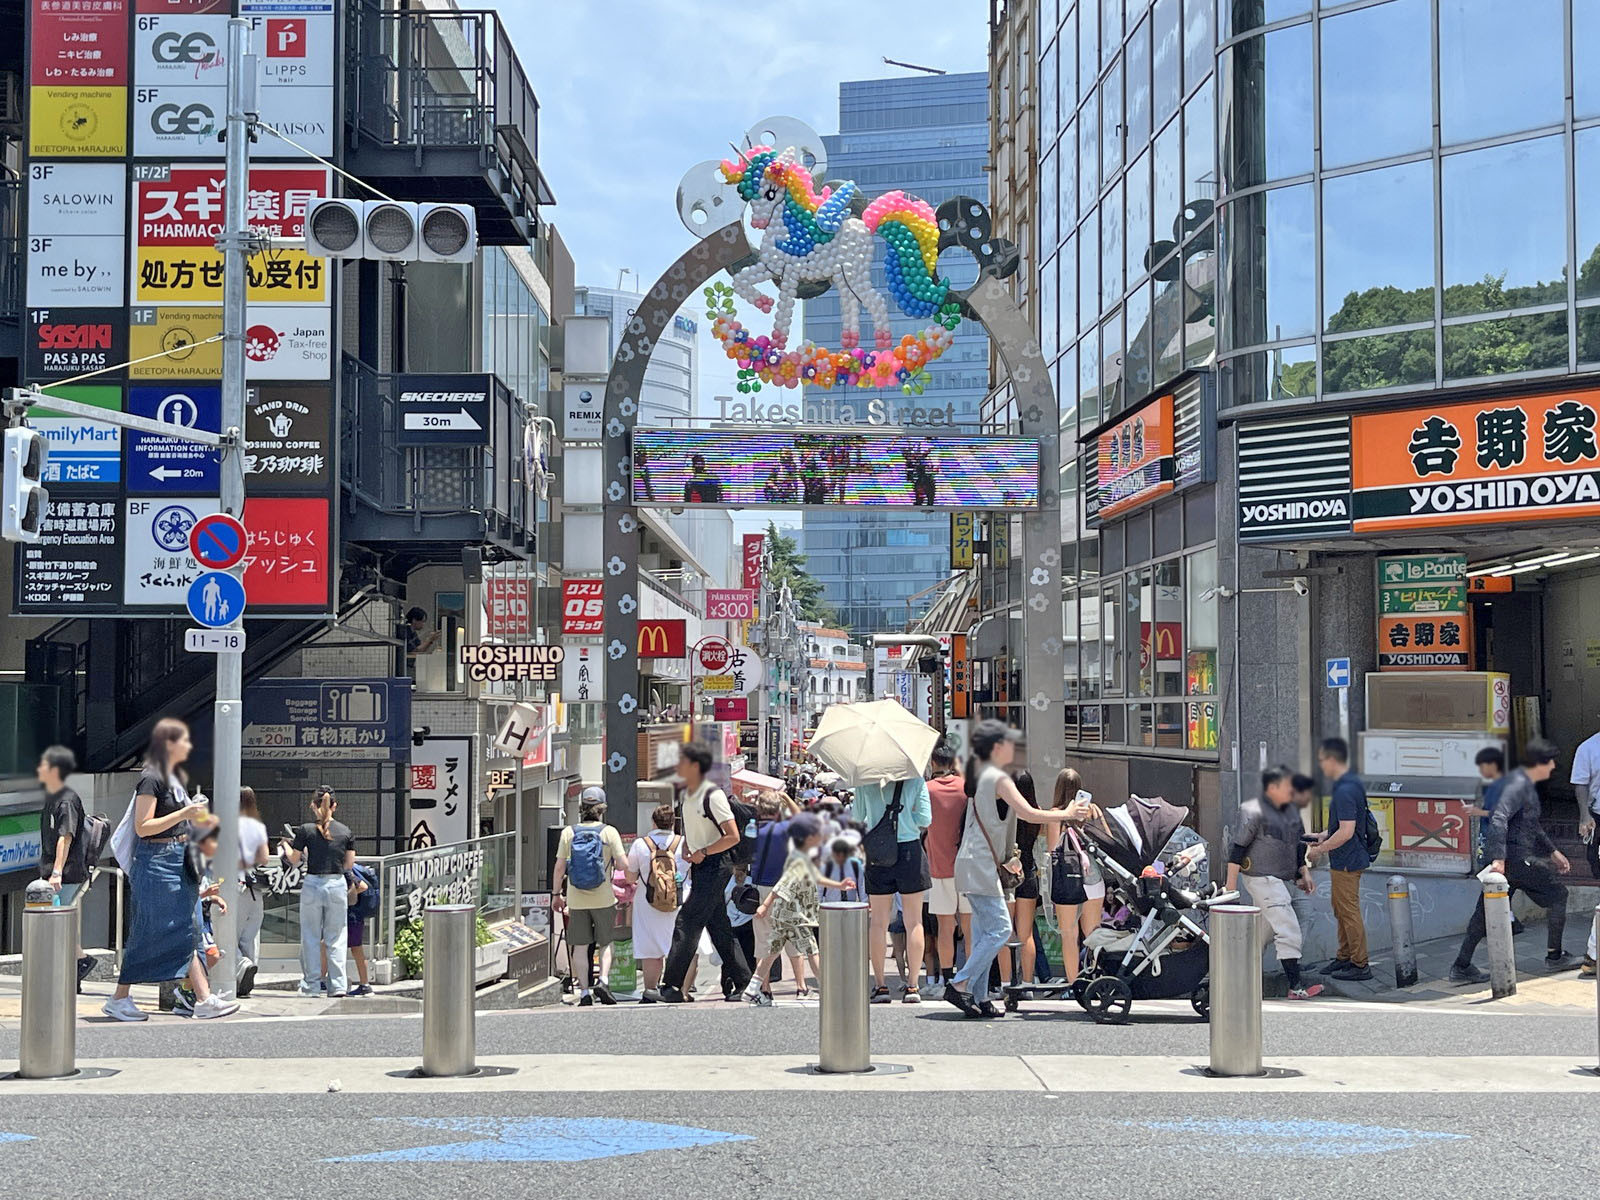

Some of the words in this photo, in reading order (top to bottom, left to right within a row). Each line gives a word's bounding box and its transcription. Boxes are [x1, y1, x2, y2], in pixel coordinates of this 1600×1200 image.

[138, 17, 160, 31] 6F
[63, 32, 98, 42] しみ治療
[57, 50, 102, 60] ニキビ治療
[45, 67, 115, 77] しわ・たるみ治療
[265, 65, 307, 76] LIPPS
[47, 91, 78, 99] Vending
[137, 89, 159, 103] 5F
[34, 145, 76, 153] BEETOPIA
[78, 145, 123, 153] HARAJUKU
[32, 166, 54, 180] 3F
[134, 166, 169, 179] 1F/2F
[43, 193, 113, 206] SALOWIN
[31, 238, 53, 253] 3F
[41, 264, 68, 277] me
[31, 310, 49, 324] 1F
[134, 310, 153, 323] 1F
[160, 312, 191, 322] Vending
[38, 324, 112, 349] SASAKI
[293, 327, 325, 338] Japan
[288, 339, 328, 349] Tax-free
[44, 353, 69, 365] PAS
[81, 353, 106, 365] PAS
[302, 351, 328, 362] Shop
[134, 367, 176, 375] BEETOPIA
[177, 367, 222, 375] HARAJUKU
[400, 392, 487, 402] SKECHERS
[254, 400, 282, 416] HAND
[285, 401, 310, 415] DRIP
[713, 396, 857, 426] Takeshita
[867, 398, 957, 428] Street
[423, 417, 451, 426] 30m
[569, 411, 602, 420] REMIX
[245, 441, 283, 449] OSHINO
[285, 441, 321, 449] COFFEE
[66, 464, 100, 480] たばこ
[183, 469, 204, 477] 20m
[1408, 474, 1600, 514] YOSHINOYA
[130, 502, 151, 515] BF
[1242, 498, 1347, 523] YOSHINOYA
[63, 533, 98, 545] Evacuation
[99, 533, 115, 545] Area
[153, 556, 198, 570] 海鮮処
[243, 555, 317, 574] アッシュ
[747, 540, 761, 586] ダイソー
[140, 571, 204, 588] さくら水
[566, 583, 603, 595] クスリ
[565, 598, 604, 617] OS
[710, 602, 749, 618] ¥300
[564, 620, 603, 631] ドラッグ
[462, 646, 565, 664] HOSHINO
[701, 650, 727, 662] 消火栓
[1388, 653, 1461, 665] YOSHINOYA
[470, 663, 556, 681] COFFEE
[285, 699, 318, 707] Baggage
[288, 707, 318, 715] Storage
[301, 727, 386, 745] 荷物預かり
[502, 720, 530, 751] H
[491, 771, 509, 784] BF
[443, 757, 459, 817] ラーメン
[396, 860, 426, 886] HAND
[427, 856, 451, 880] DRIP
[450, 849, 484, 875] COFFEE
